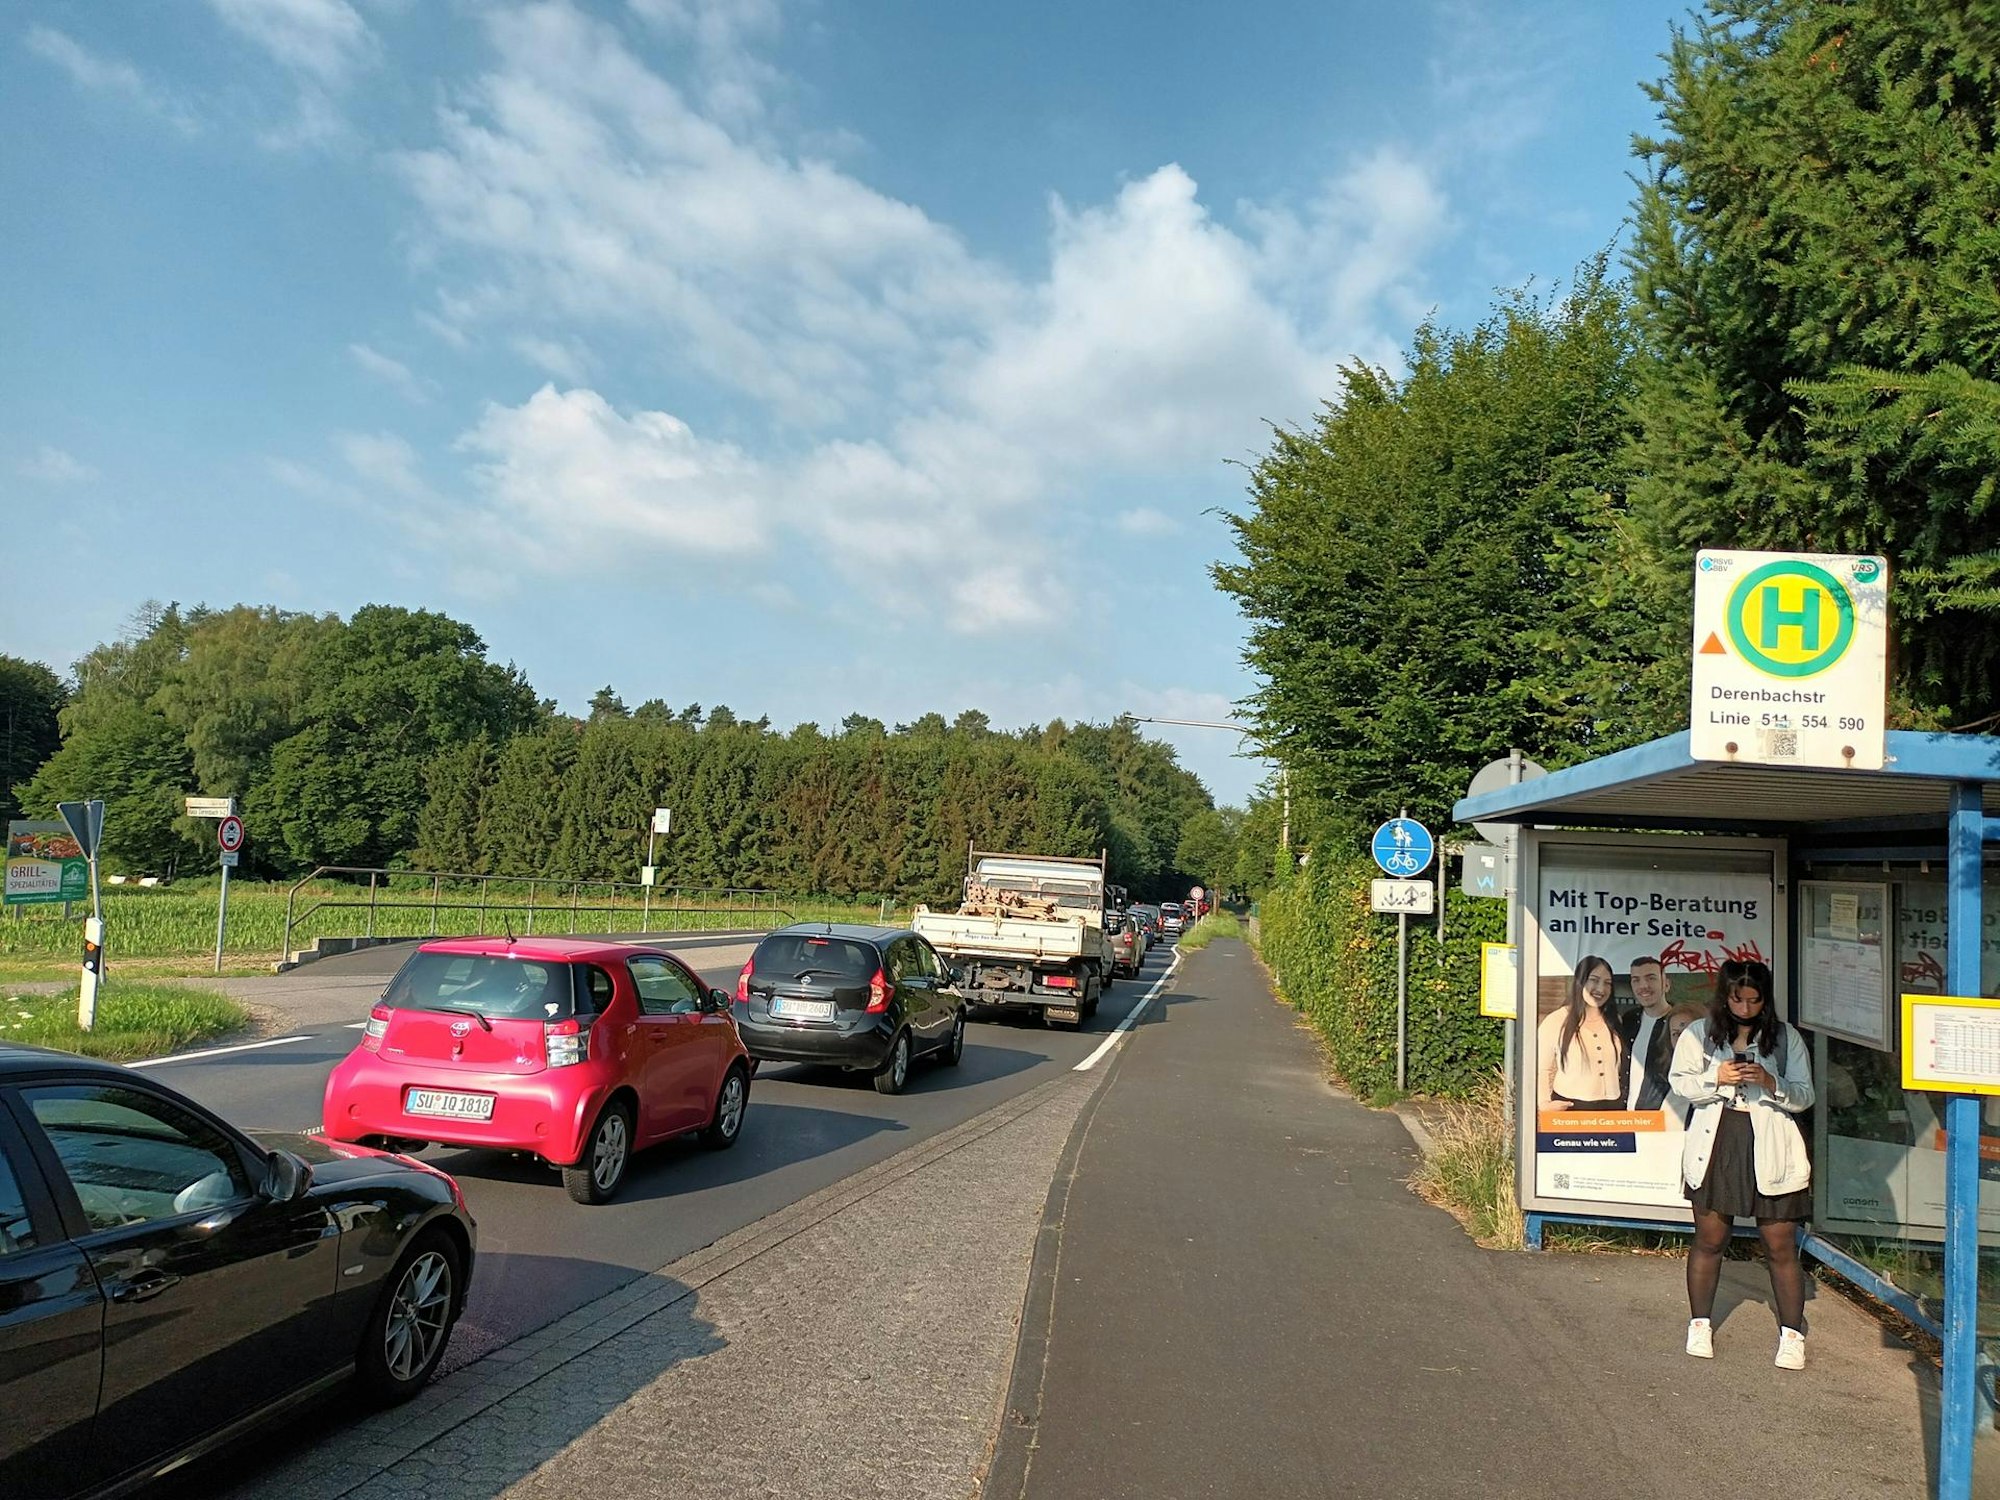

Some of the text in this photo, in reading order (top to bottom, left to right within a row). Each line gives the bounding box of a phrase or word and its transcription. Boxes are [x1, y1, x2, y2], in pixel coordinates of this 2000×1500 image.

[1851, 563, 1873, 573] VRS
[1761, 586, 1820, 651] H
[1711, 686, 1826, 704] Derenbachstr
[1710, 711, 1751, 726] Linie
[1802, 715, 1828, 729] 554
[1838, 717, 1865, 731] 590
[11, 866, 47, 878] GRILL-
[1549, 889, 1758, 920] Mit Top-Beratung
[1549, 915, 1706, 939] an Ihrer Seite
[416, 1094, 490, 1114] SU IQ 1818
[1552, 1117, 1654, 1127] Strom und Gas von hier.
[1554, 1138, 1618, 1148] Genau wie wir.
